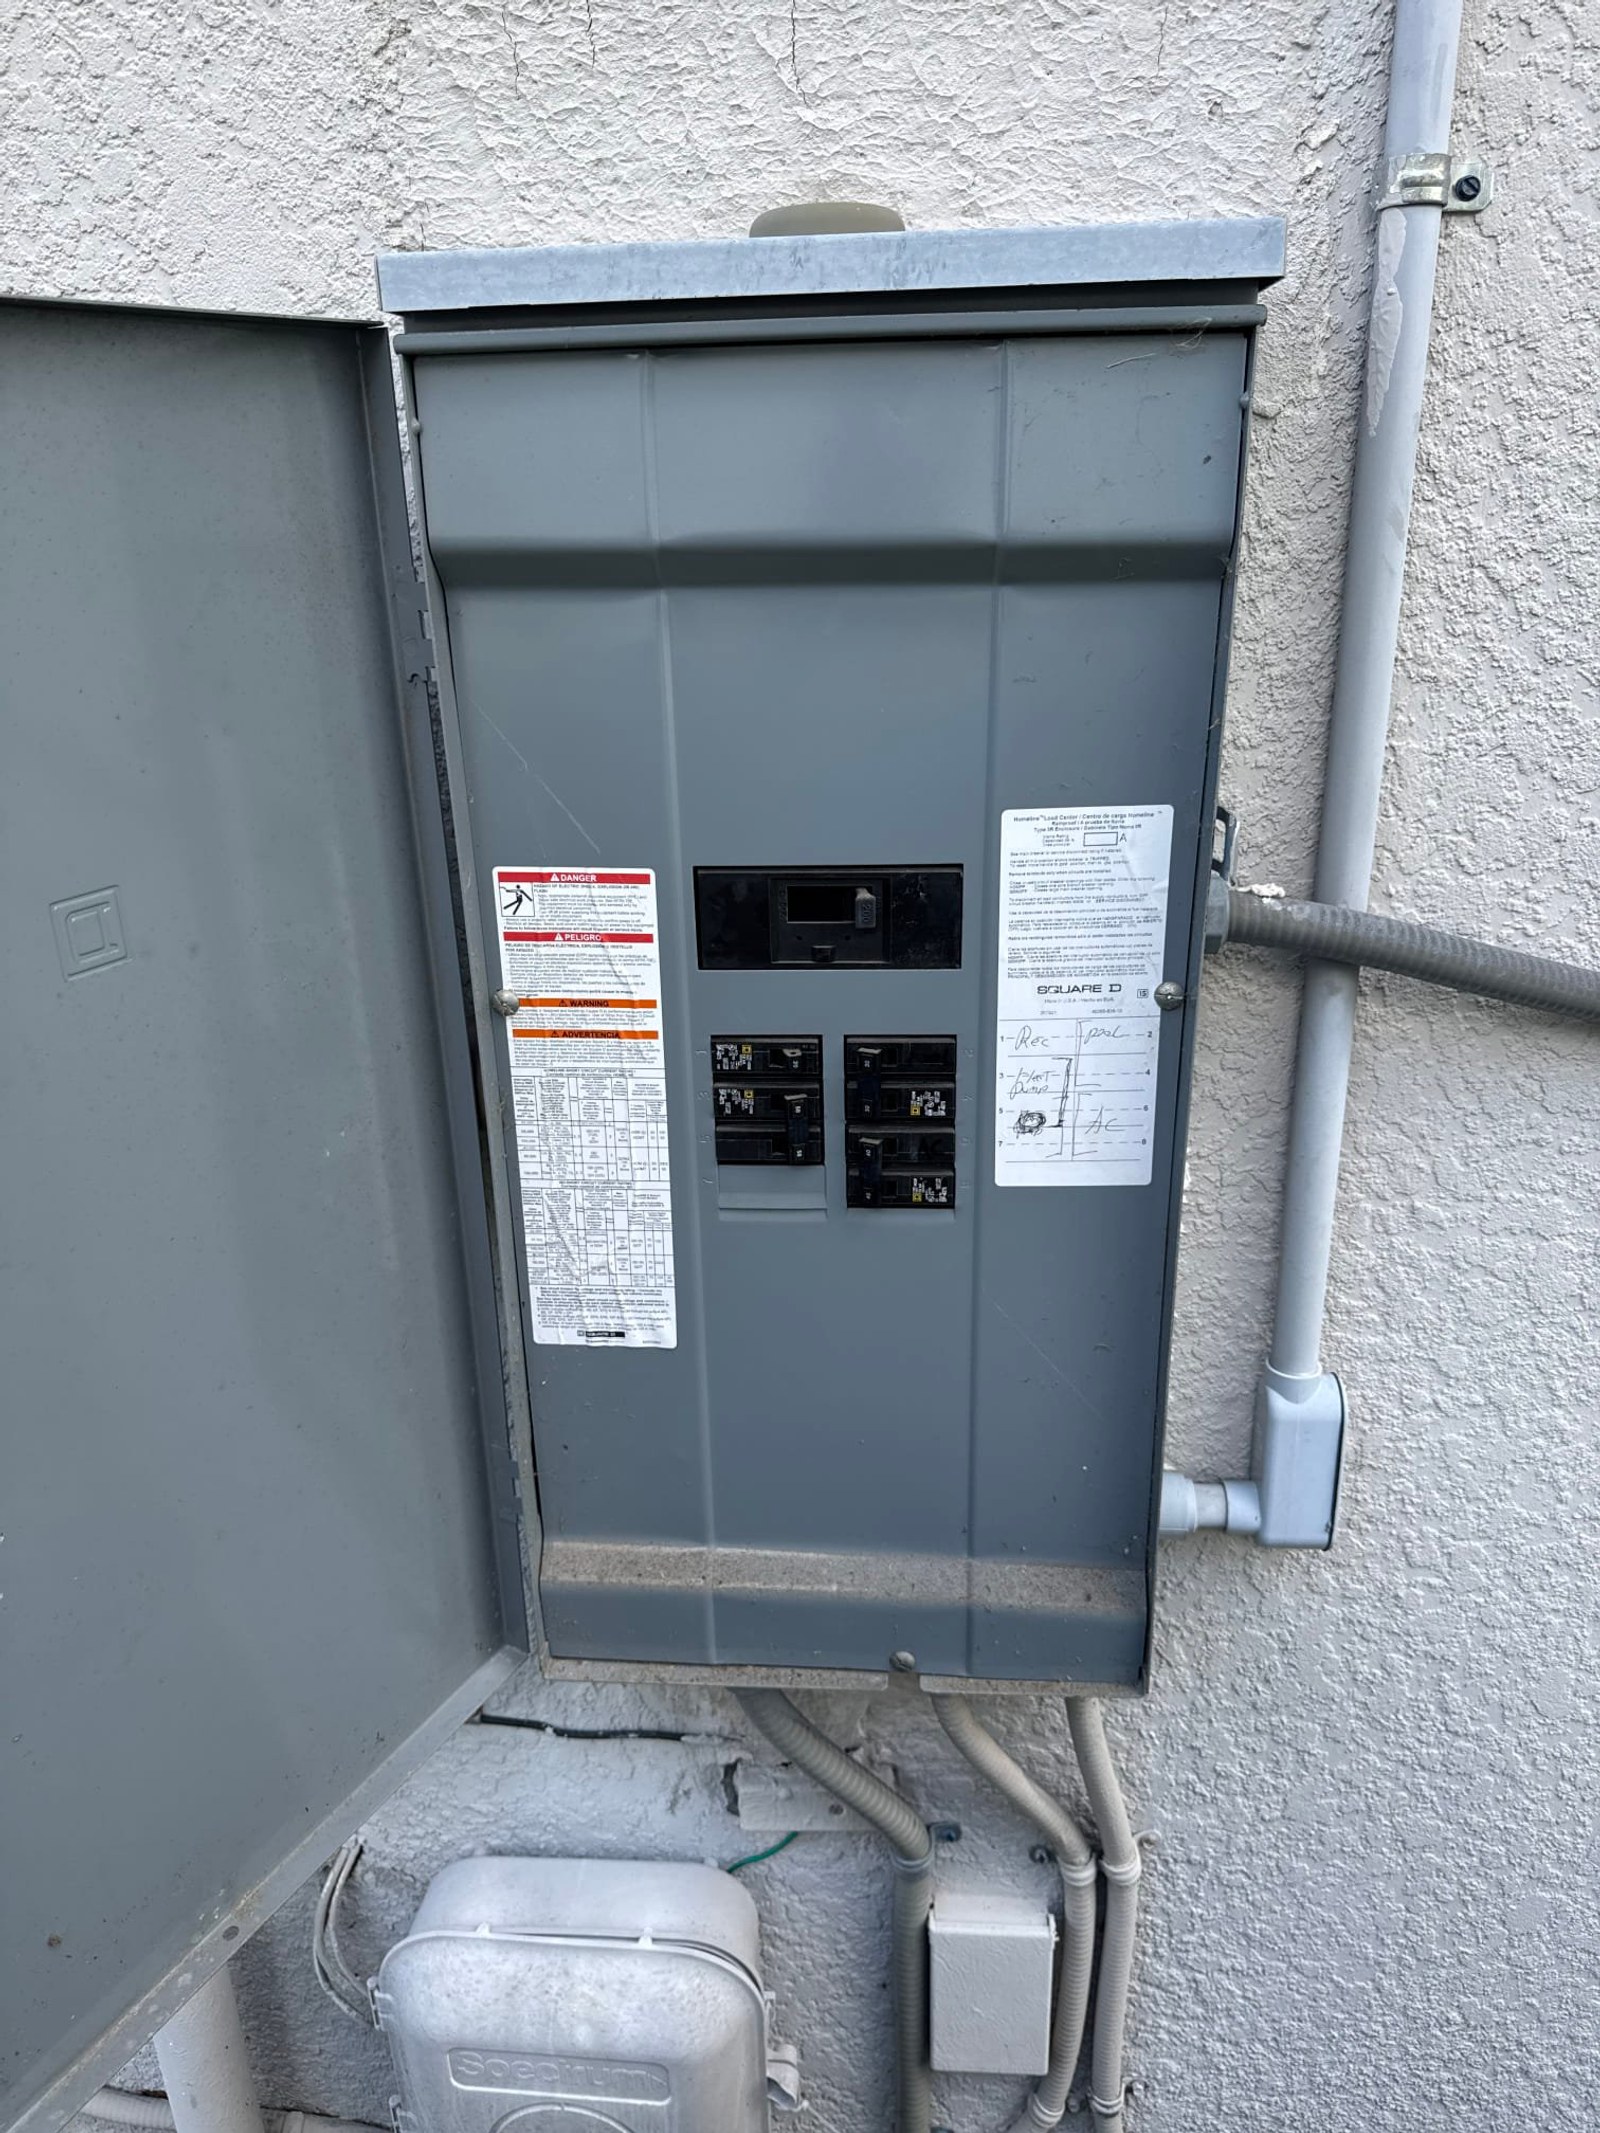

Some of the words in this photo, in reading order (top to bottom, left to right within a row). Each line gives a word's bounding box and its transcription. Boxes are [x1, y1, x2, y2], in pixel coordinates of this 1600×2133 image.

[1119, 833, 1127, 842] A
[560, 874, 597, 882] DANGER
[564, 933, 601, 941] PELIGRO
[1037, 984, 1103, 994] SQUARE
[1109, 983, 1122, 993] D
[562, 1031, 621, 1039] ADVERTENCIA
[1085, 1105, 1126, 1134] AC
